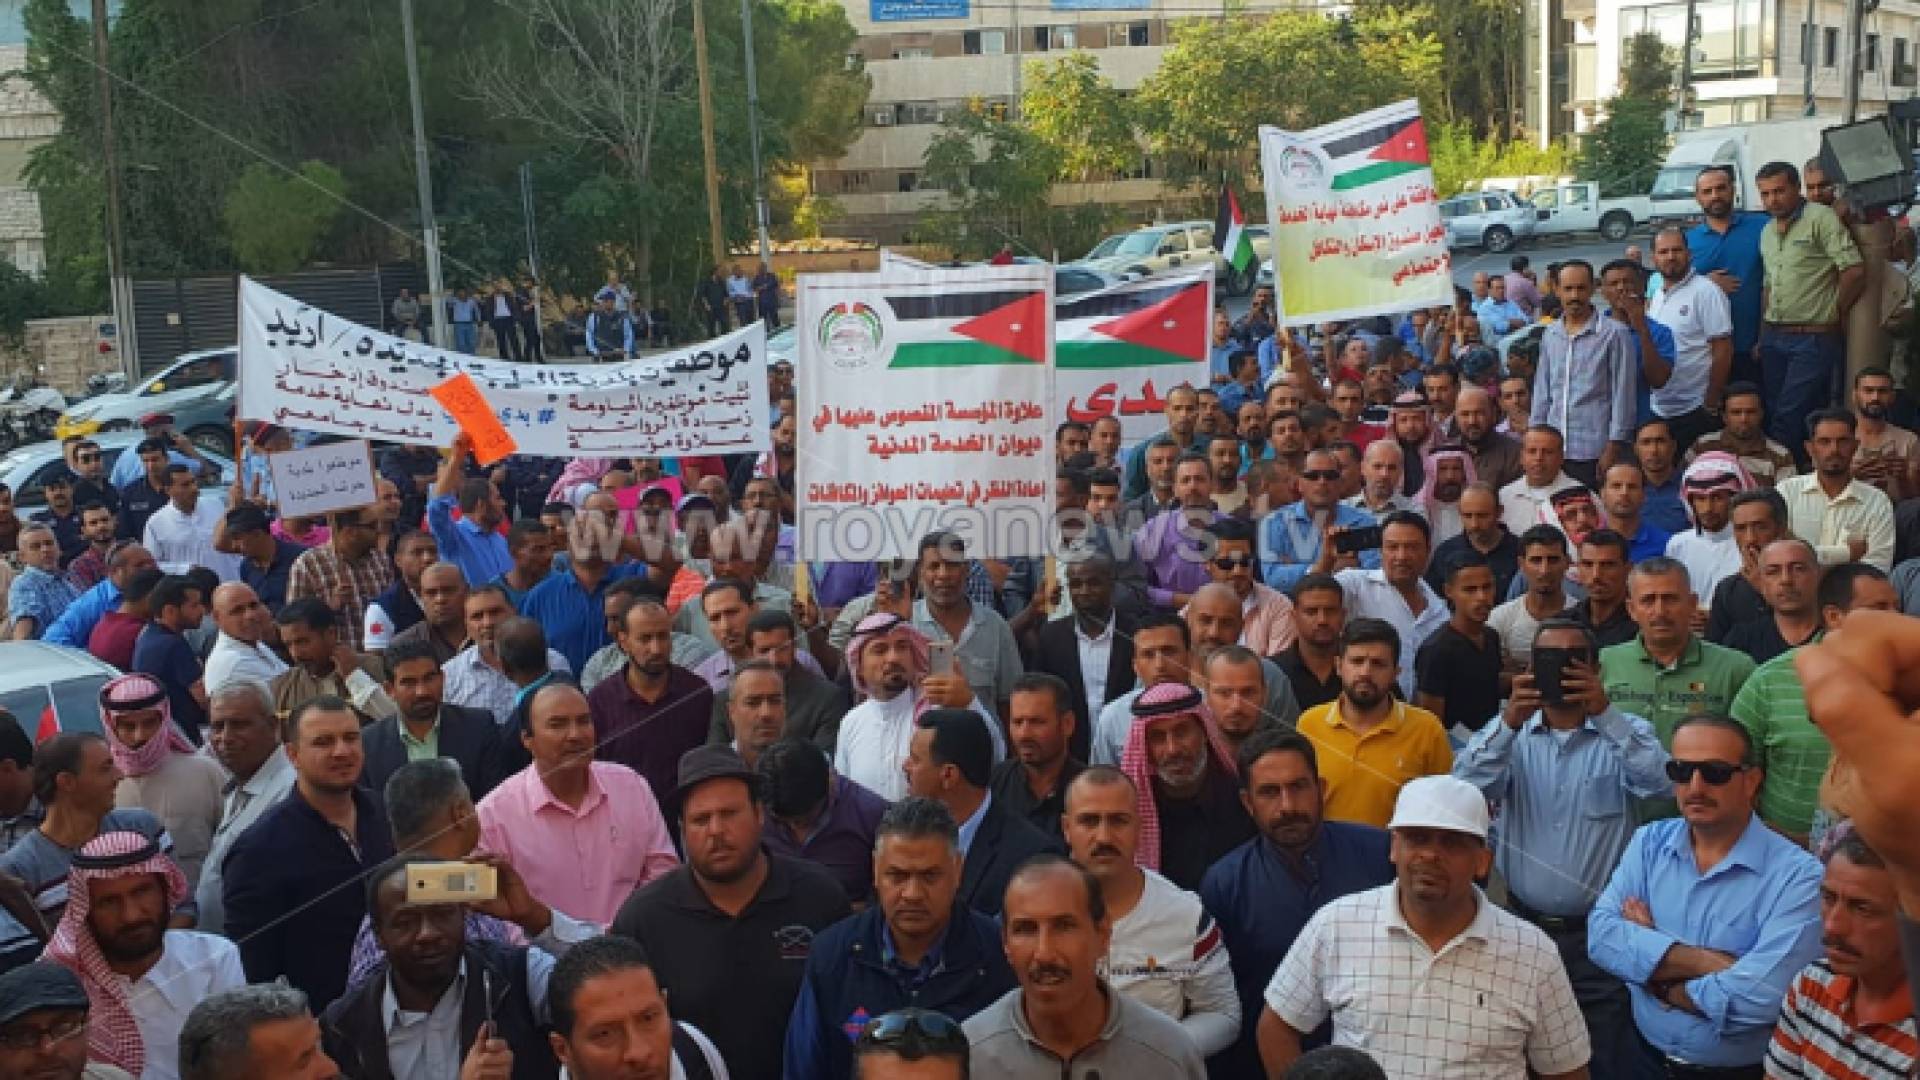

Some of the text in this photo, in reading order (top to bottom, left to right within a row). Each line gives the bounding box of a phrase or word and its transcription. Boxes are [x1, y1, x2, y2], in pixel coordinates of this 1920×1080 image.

[812, 404, 833, 433] في
[1004, 400, 1043, 424] علاوة
[866, 431, 1043, 459] ديوان الخدمة المدنية
